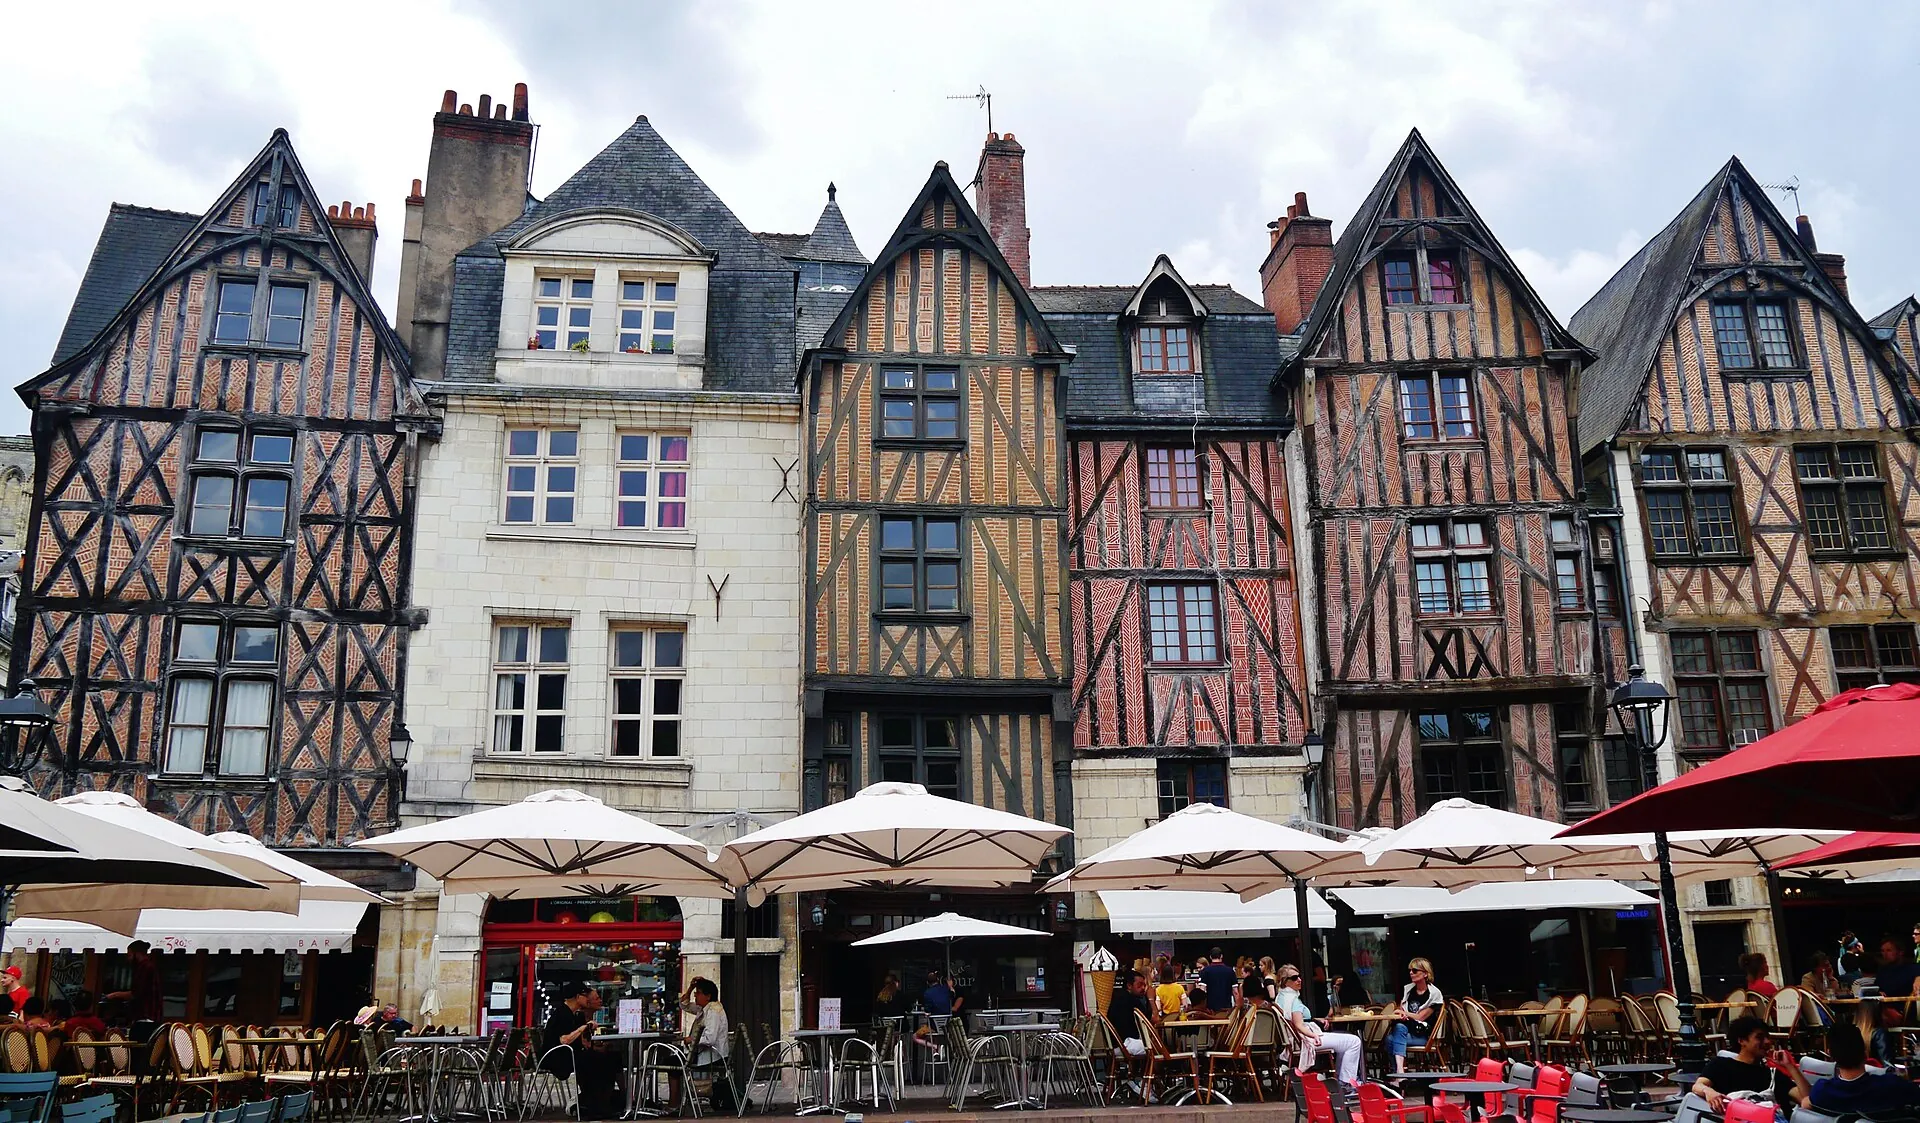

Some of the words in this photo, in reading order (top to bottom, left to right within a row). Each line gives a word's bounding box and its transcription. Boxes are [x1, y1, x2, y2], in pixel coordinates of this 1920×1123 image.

[27, 938, 61, 946] BAR
[165, 936, 175, 952] 3
[298, 939, 331, 948] BAR
